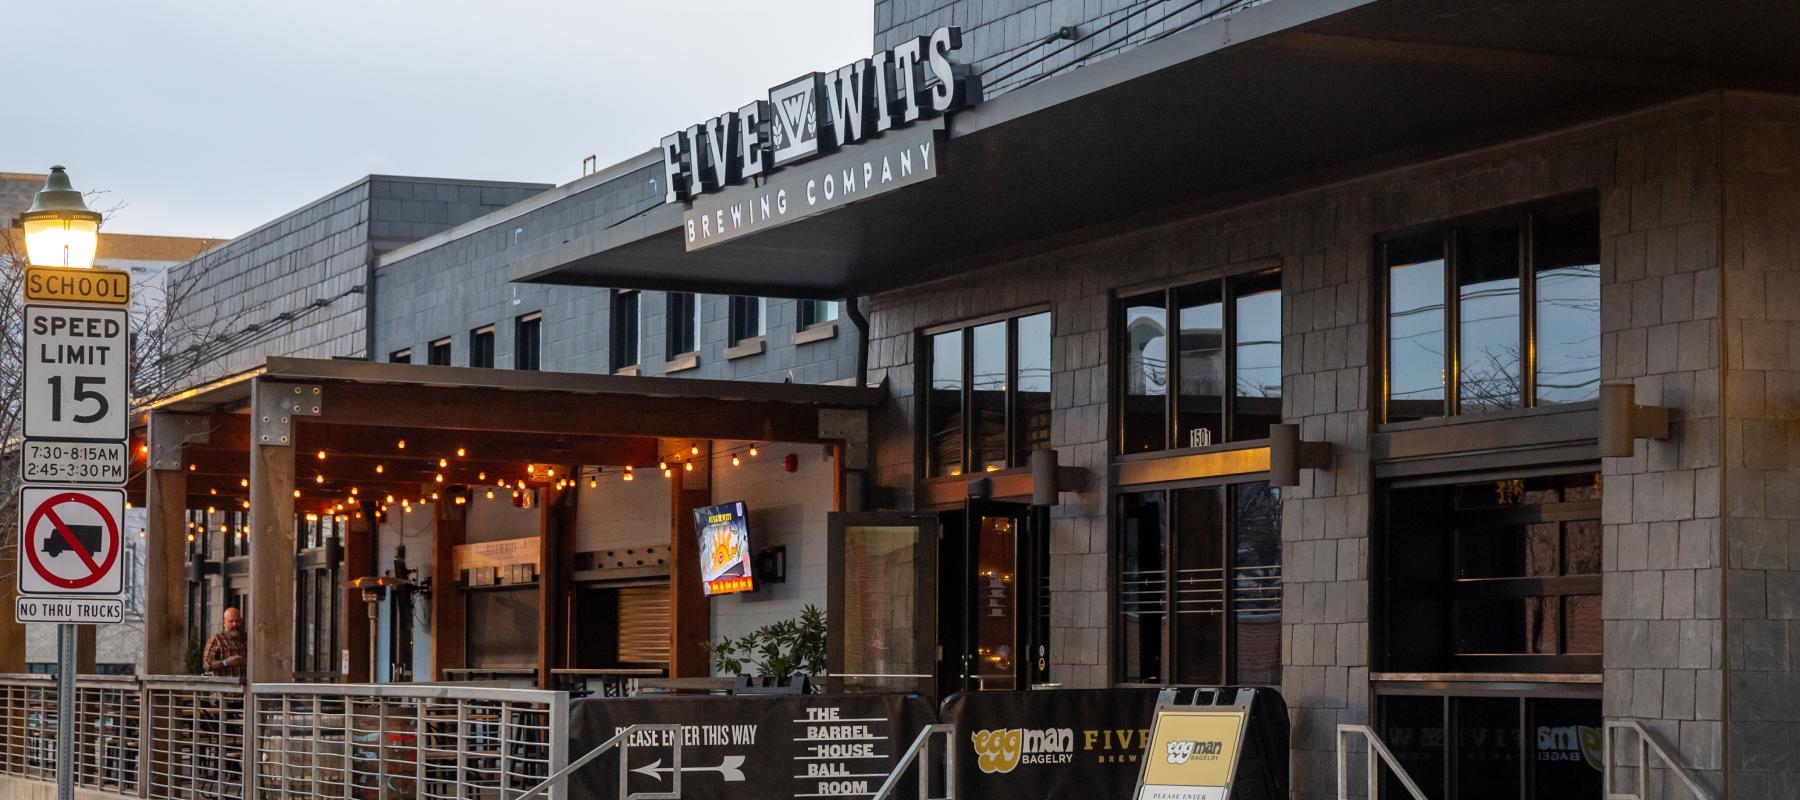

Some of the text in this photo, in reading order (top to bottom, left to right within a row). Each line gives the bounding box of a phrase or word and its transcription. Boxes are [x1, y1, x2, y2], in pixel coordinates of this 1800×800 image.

[661, 99, 763, 204] FIVE
[824, 26, 955, 148] WITS
[687, 142, 931, 243] BREWING COMPANY
[30, 274, 125, 298] SCHOOL
[33, 315, 120, 339] SPEED
[41, 343, 111, 366] LIMIT
[47, 375, 109, 424] 15
[1190, 427, 1211, 448] 1501
[102, 465, 122, 477] PM
[20, 603, 120, 618] NO THRU TRUCKS
[806, 707, 840, 721] THE
[702, 725, 729, 746] THIS
[731, 724, 757, 746] WAY
[807, 725, 874, 739] BARREL
[972, 727, 1074, 774] eggman
[1022, 753, 1073, 764] BAGELRY
[1098, 755, 1144, 764] BREW
[1167, 740, 1223, 765] eggman
[808, 763, 850, 777] BALL
[818, 781, 868, 795] ROOM
